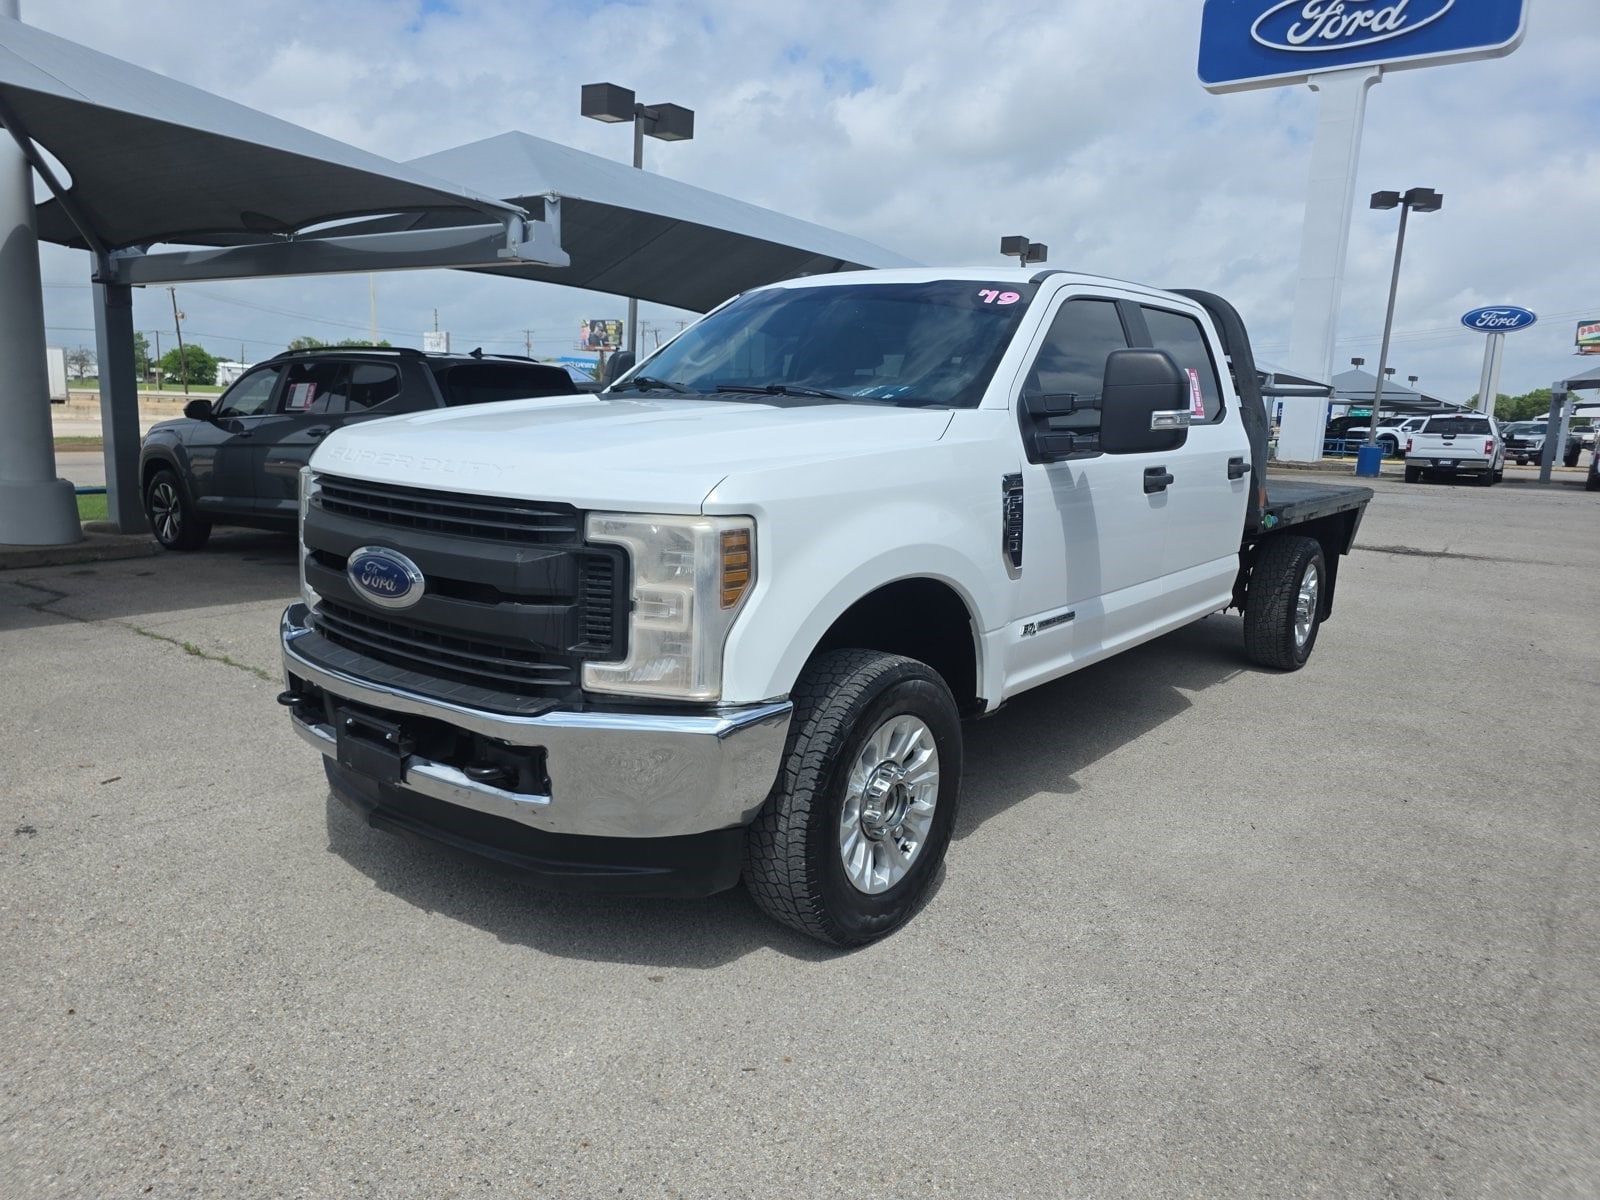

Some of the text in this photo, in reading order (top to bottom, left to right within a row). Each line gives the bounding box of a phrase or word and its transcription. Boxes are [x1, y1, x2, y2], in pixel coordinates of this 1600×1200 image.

[1287, 0, 1407, 44] Ford
[1475, 310, 1521, 327] Ford
[329, 446, 517, 479] SUPER DUTY
[361, 561, 397, 592] Ford
